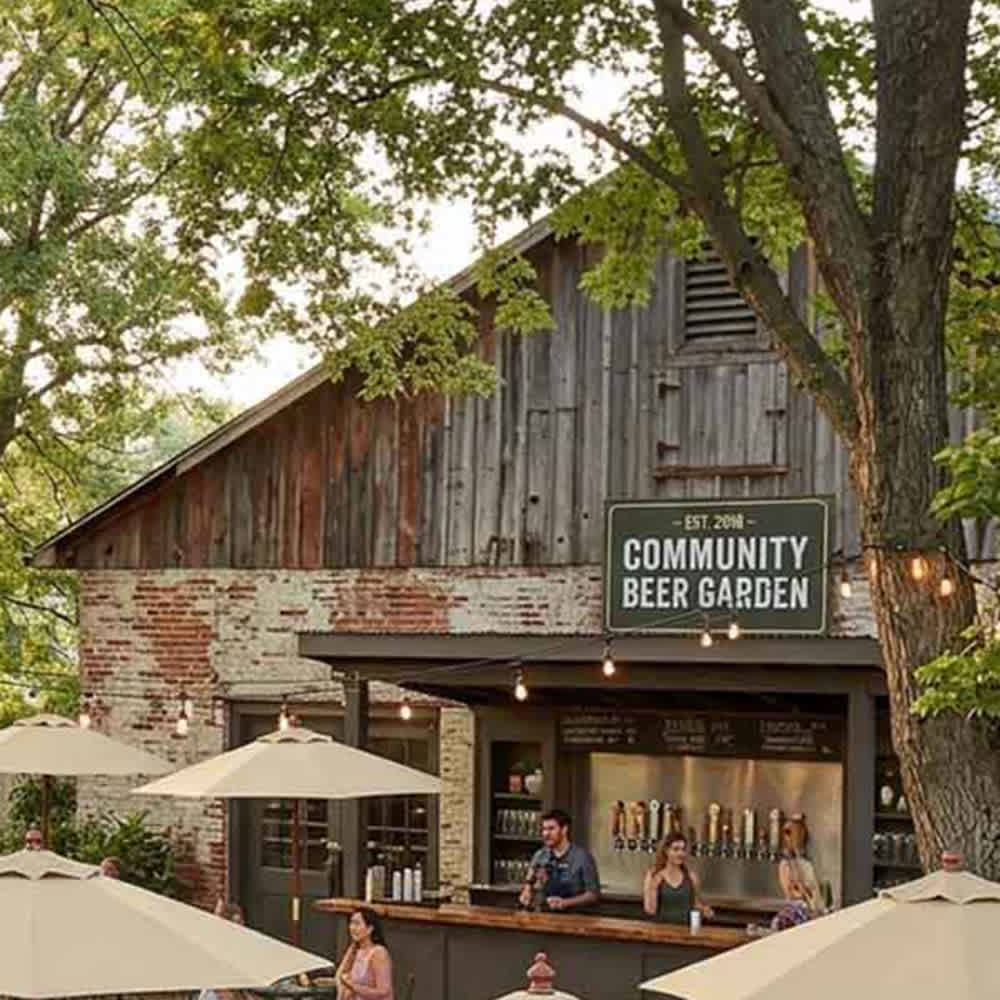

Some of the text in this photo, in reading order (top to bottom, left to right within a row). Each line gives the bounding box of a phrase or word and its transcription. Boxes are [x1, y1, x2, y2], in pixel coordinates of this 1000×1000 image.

[623, 536, 809, 571] COMMUNITY
[622, 576, 809, 609] BEER GARDEN
